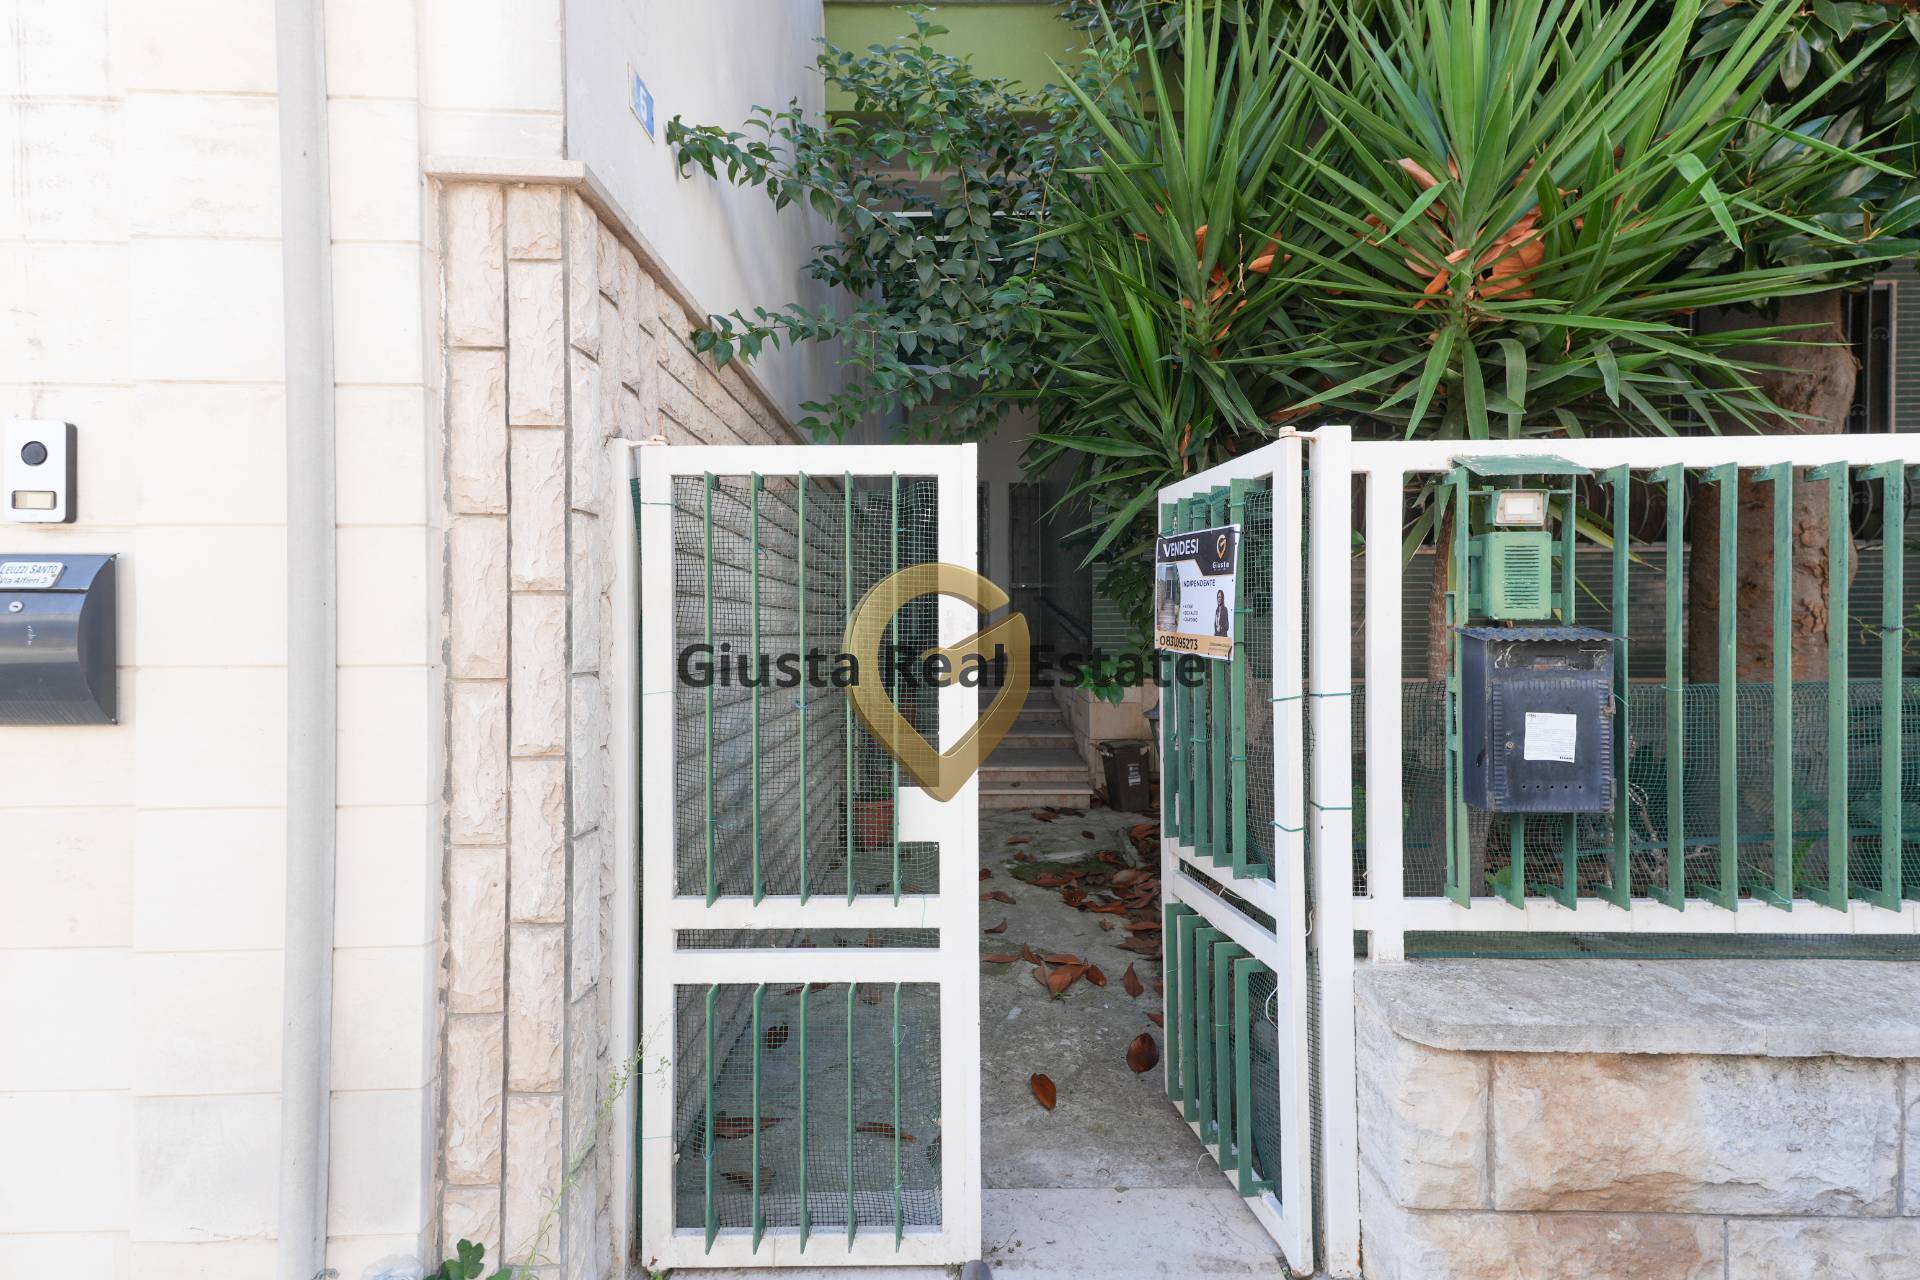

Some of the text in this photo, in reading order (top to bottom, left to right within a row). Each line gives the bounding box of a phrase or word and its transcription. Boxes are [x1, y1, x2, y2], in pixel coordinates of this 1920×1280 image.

[1163, 538, 1199, 558] VENDESI
[29, 563, 57, 575] SANTO
[1212, 561, 1231, 569] Giusta
